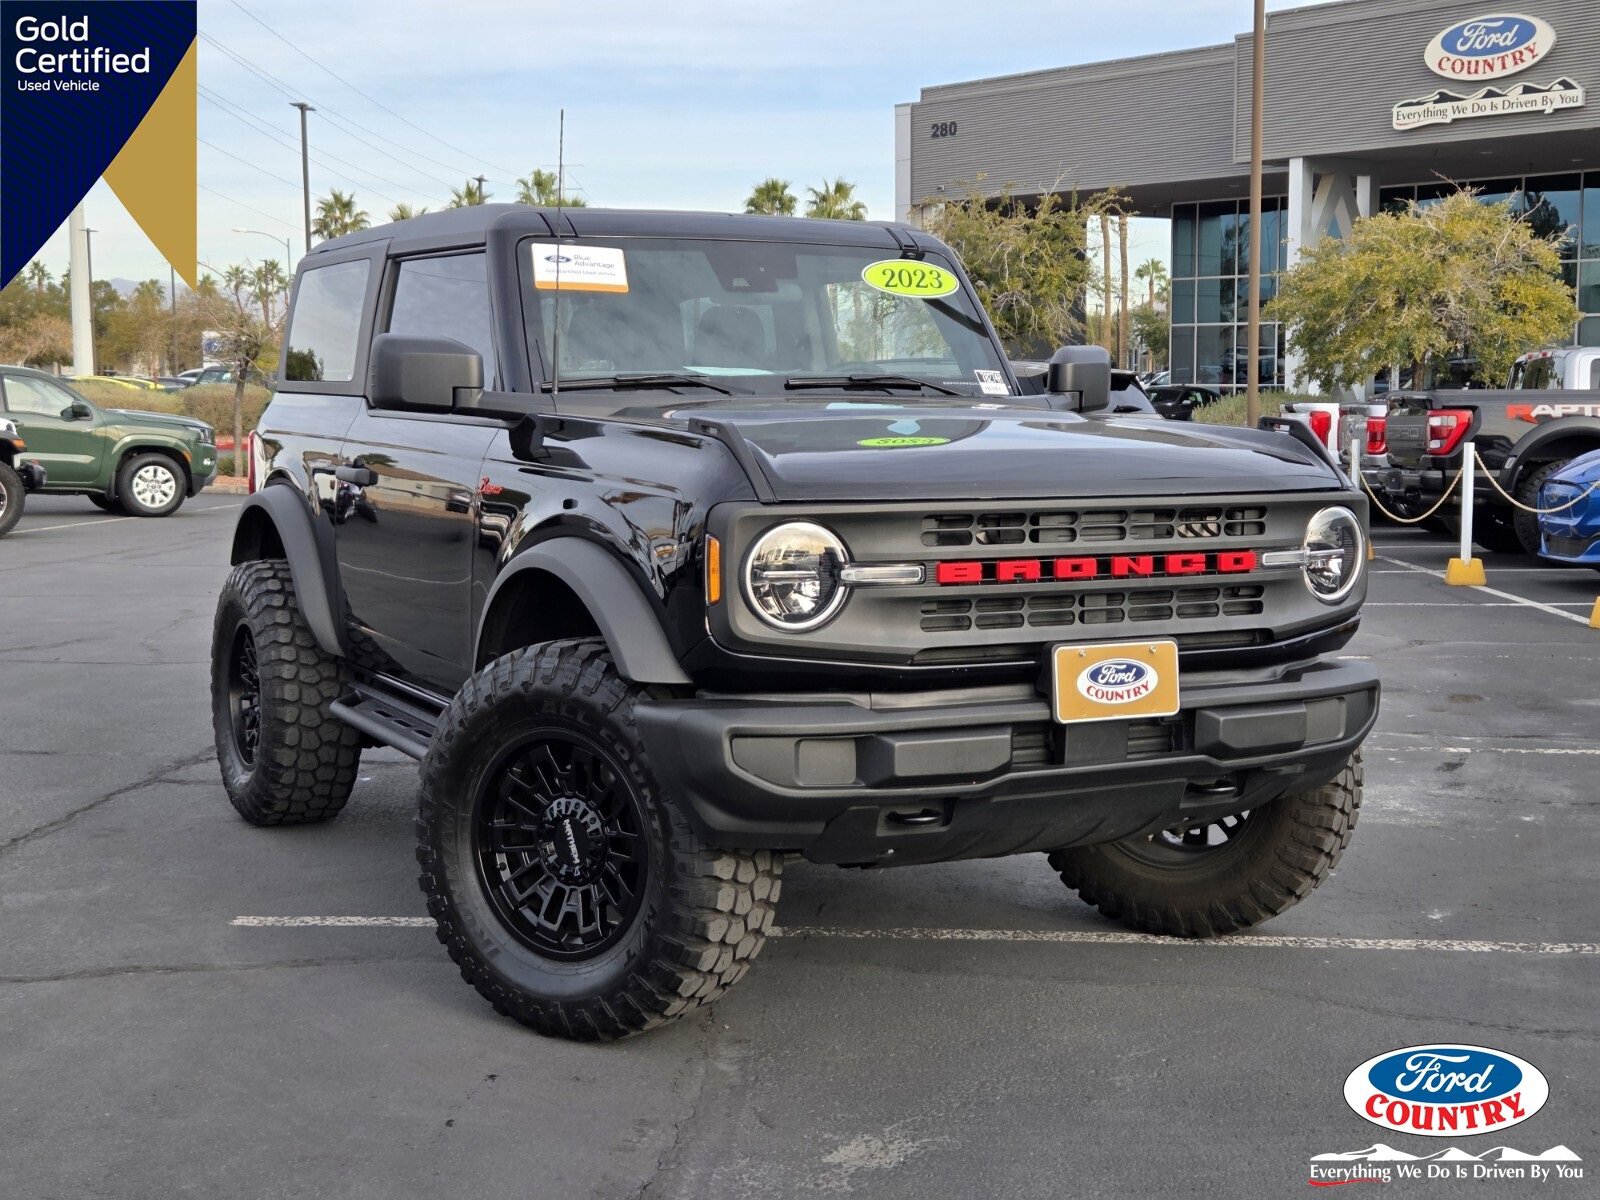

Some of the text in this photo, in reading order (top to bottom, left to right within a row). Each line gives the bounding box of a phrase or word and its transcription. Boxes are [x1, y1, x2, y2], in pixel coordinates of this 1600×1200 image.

[1456, 20, 1520, 52] Ford
[1437, 41, 1539, 75] COUNTRY
[1396, 93, 1579, 122] Everything We Do Is Driven By You
[931, 121, 957, 137] 280
[574, 261, 616, 269] Advantage
[881, 268, 943, 289] 2023
[1507, 403, 1600, 425] RAPT
[936, 550, 1258, 585] BRONCO
[1097, 663, 1137, 684] Ford
[1086, 680, 1150, 701] COUNTRY
